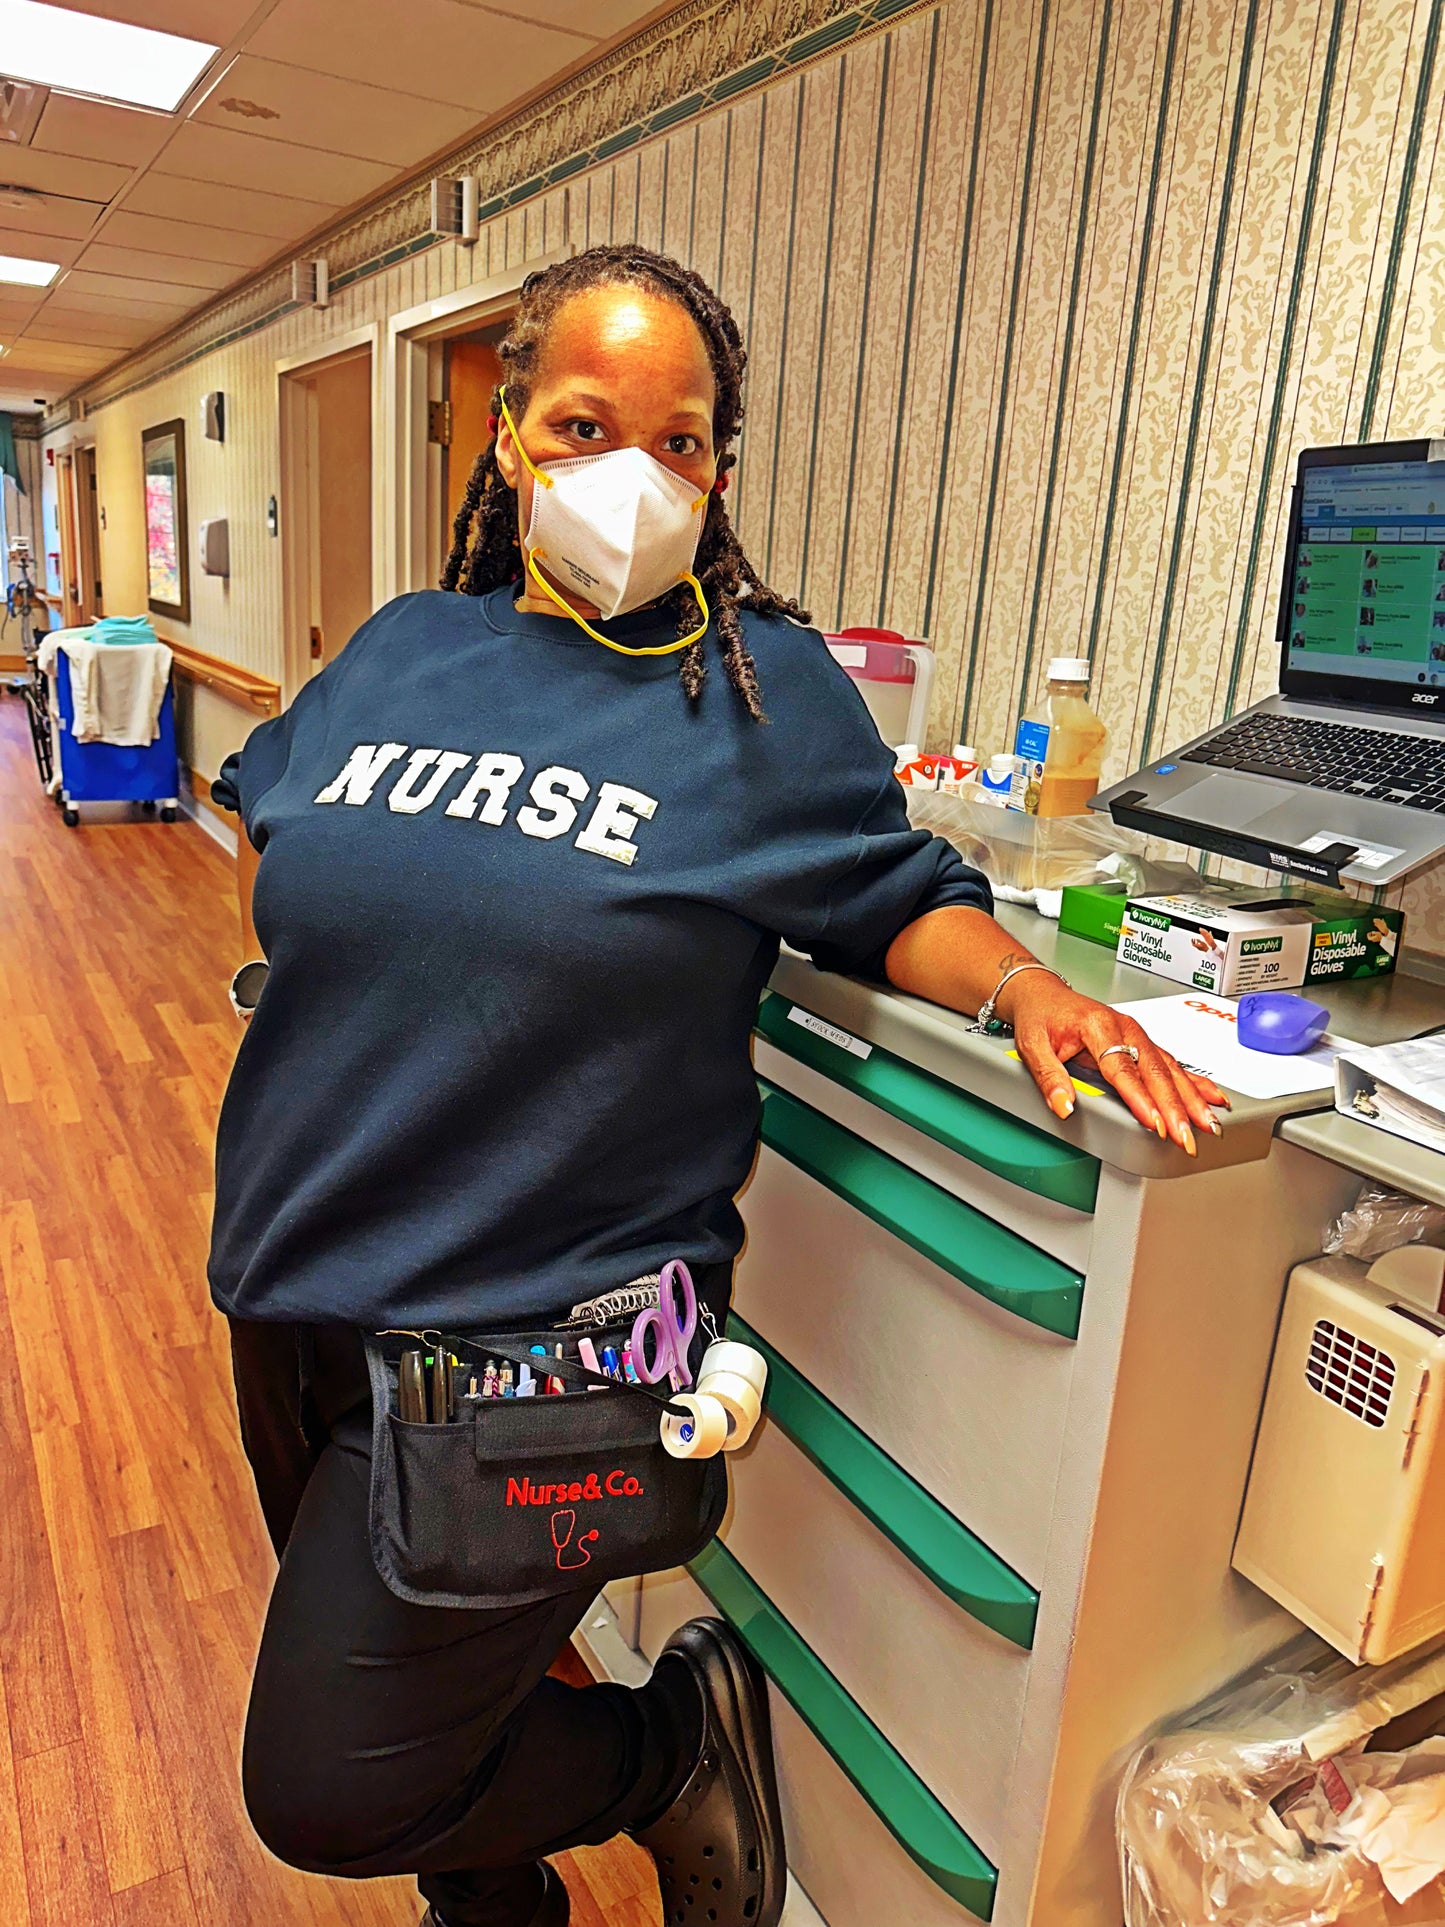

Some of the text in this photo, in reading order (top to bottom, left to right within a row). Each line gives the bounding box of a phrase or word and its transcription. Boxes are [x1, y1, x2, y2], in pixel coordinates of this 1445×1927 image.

[1411, 693, 1439, 705] acer
[314, 742, 658, 866] NURSE
[1141, 931, 1163, 949] Vinyl
[1332, 929, 1357, 948] Vinyl
[1122, 949, 1152, 967] Gloves
[1124, 937, 1172, 962] Disposable
[1312, 943, 1367, 962] Disposable
[1200, 960, 1216, 971] 100
[1263, 962, 1280, 973] 100
[1310, 961, 1345, 976] Gloves
[1195, 974, 1212, 985] LARGE
[506, 1470, 644, 1506] Nurse& Co.
